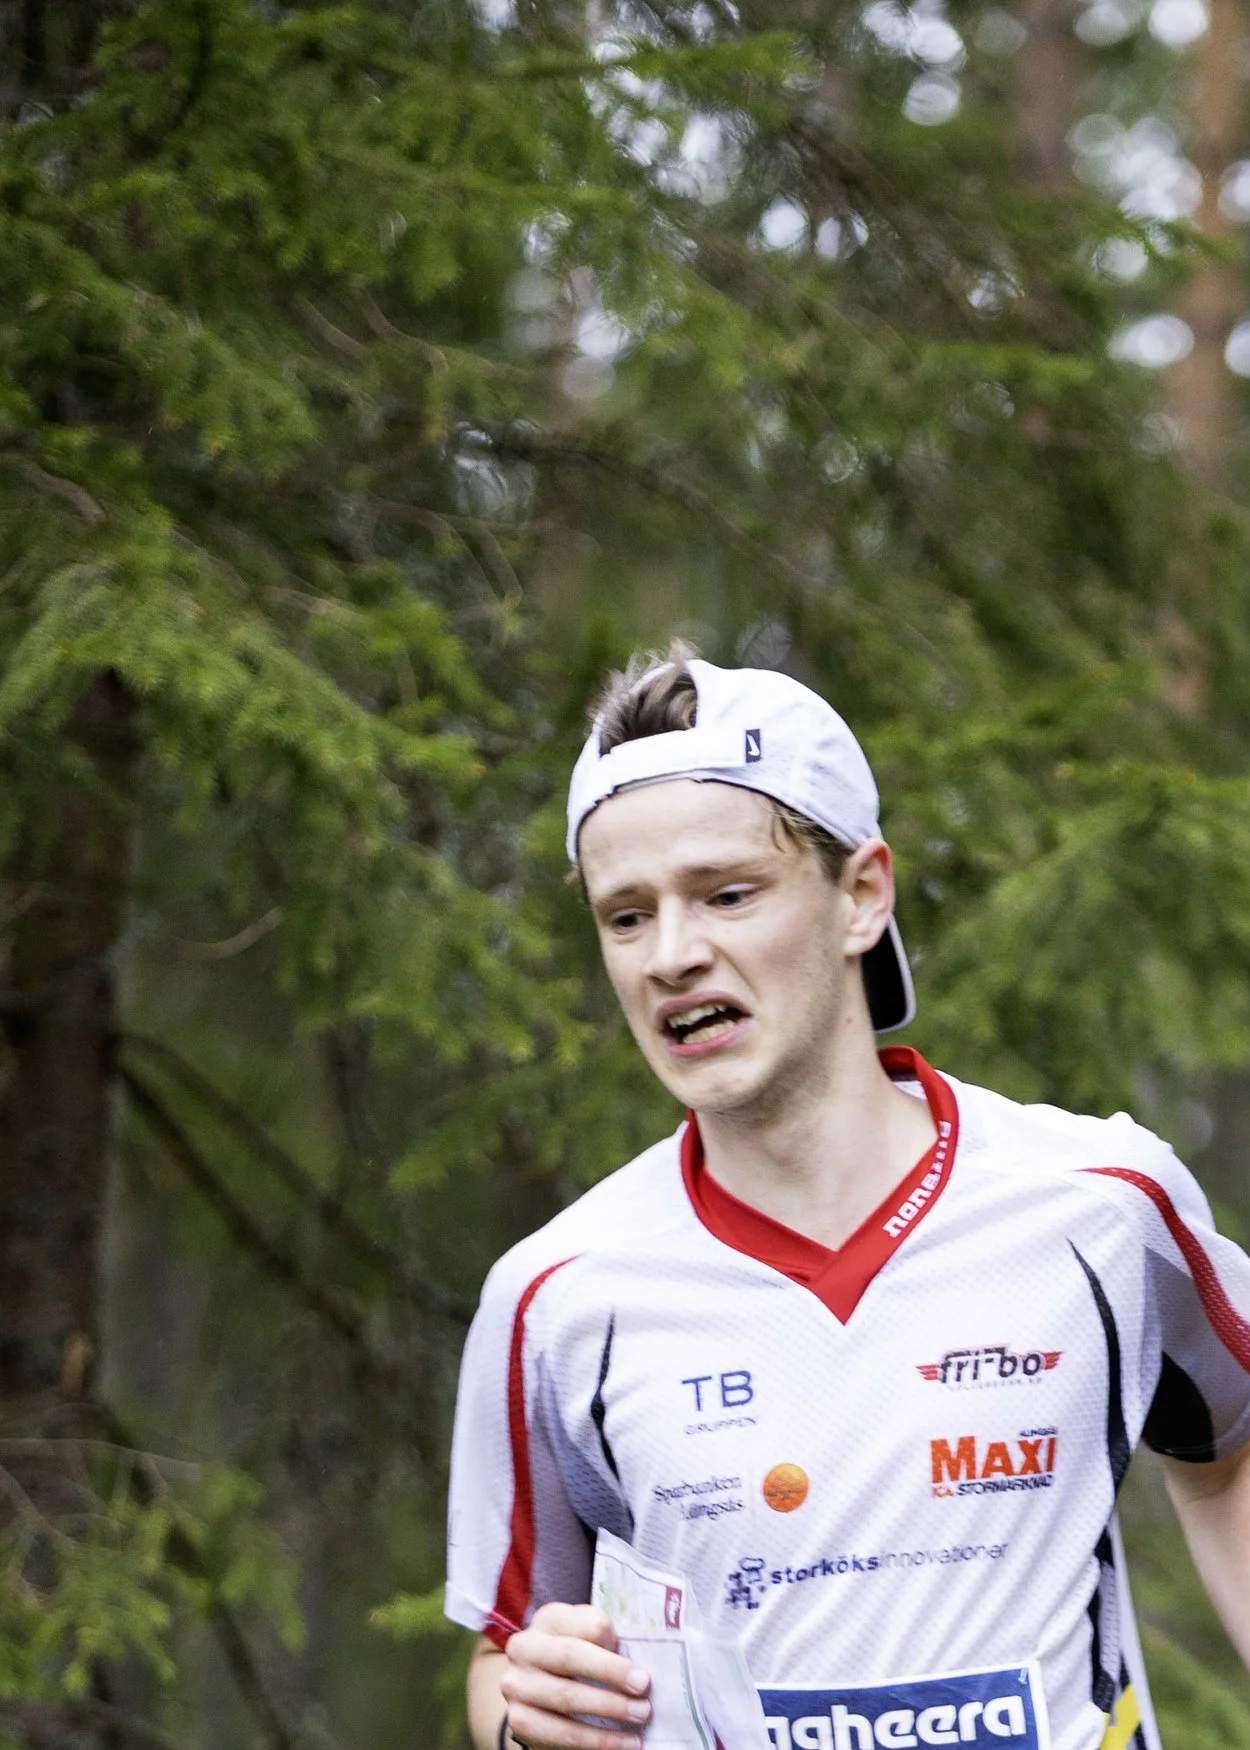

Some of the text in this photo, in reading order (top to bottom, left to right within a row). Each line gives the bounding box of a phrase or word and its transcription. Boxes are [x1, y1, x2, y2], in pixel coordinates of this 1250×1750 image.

[940, 1347, 1041, 1384] fri-bo
[682, 1370, 754, 1412] TB
[931, 1436, 1057, 1484] MAXI
